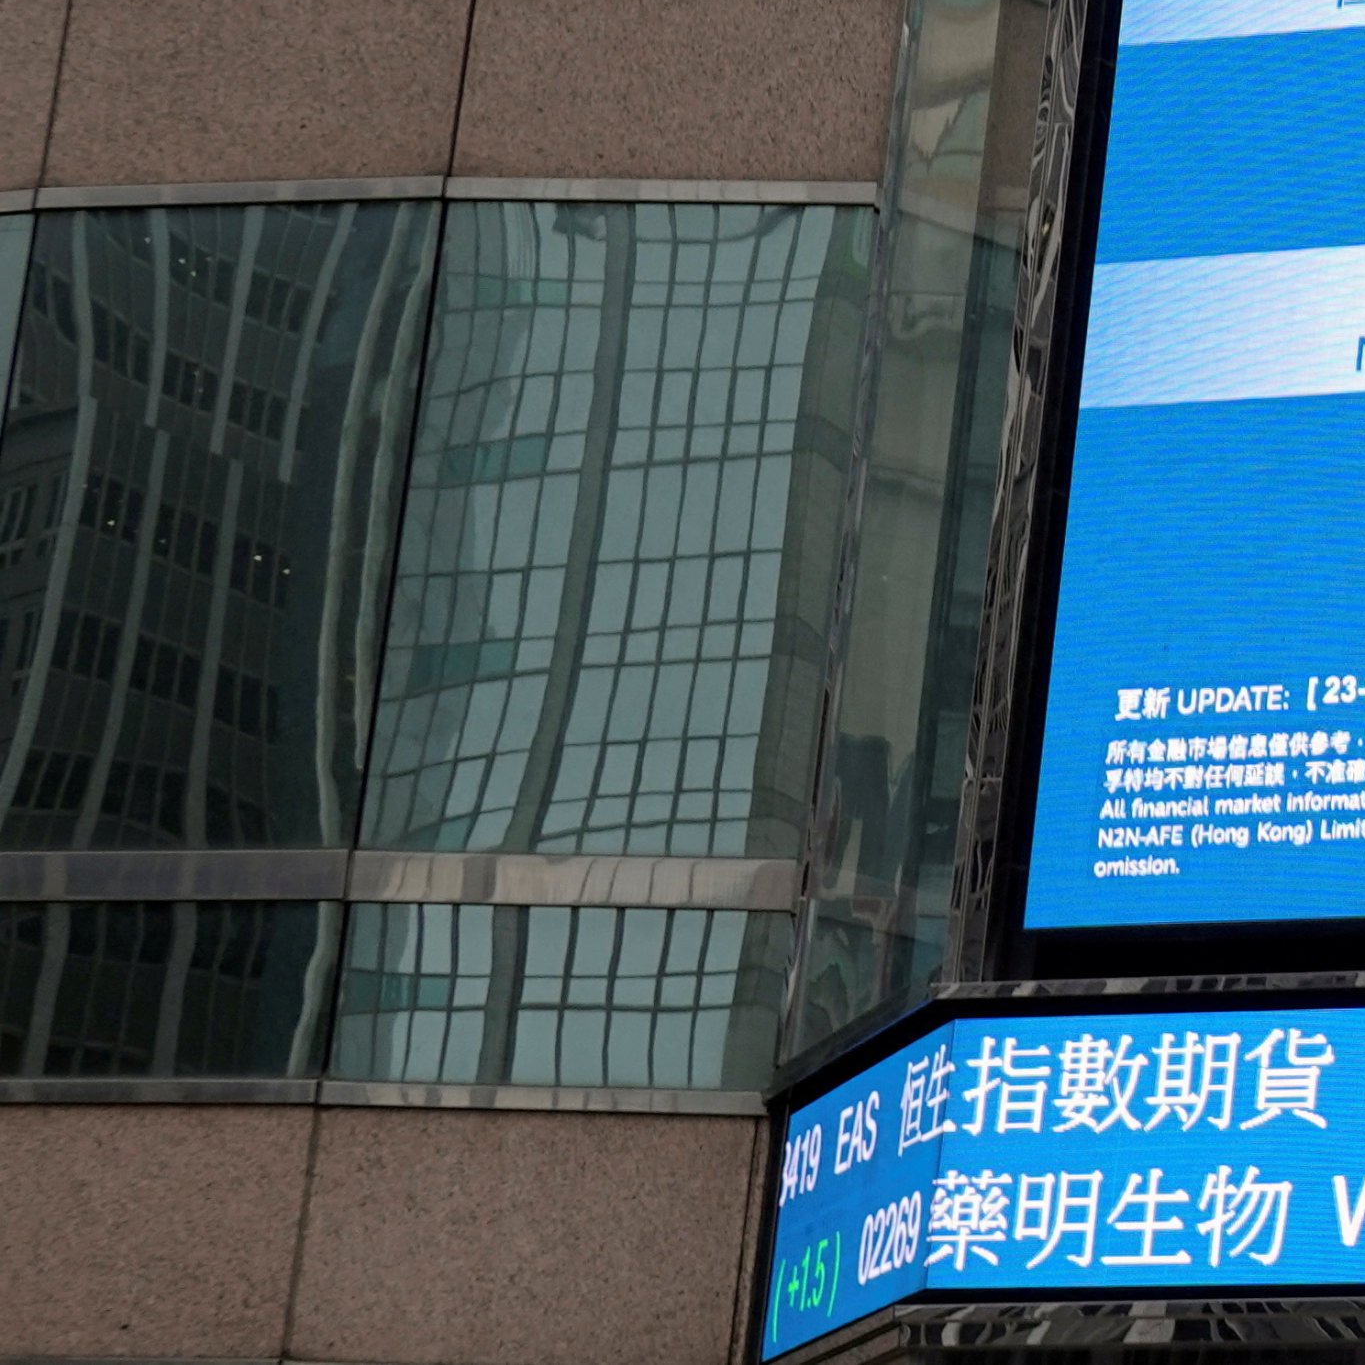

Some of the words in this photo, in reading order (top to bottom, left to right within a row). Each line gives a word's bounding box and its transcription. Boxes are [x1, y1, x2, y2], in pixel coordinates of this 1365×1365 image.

[1115, 687, 1172, 722] 更新
[1176, 685, 1290, 716] UPDATE:
[1099, 798, 1128, 819] All
[1131, 792, 1209, 817] financial
[1214, 792, 1282, 815] market
[1097, 824, 1184, 848] N2N-AFE
[1191, 824, 1250, 848] (Hong
[1257, 819, 1314, 846] Kong)
[1093, 855, 1180, 878] omission.
[834, 1090, 880, 1175] EAS
[899, 1028, 1336, 1157] 恒生指數期貨
[857, 1189, 922, 1286] 02269
[923, 1164, 1294, 1272] 藥明生物
